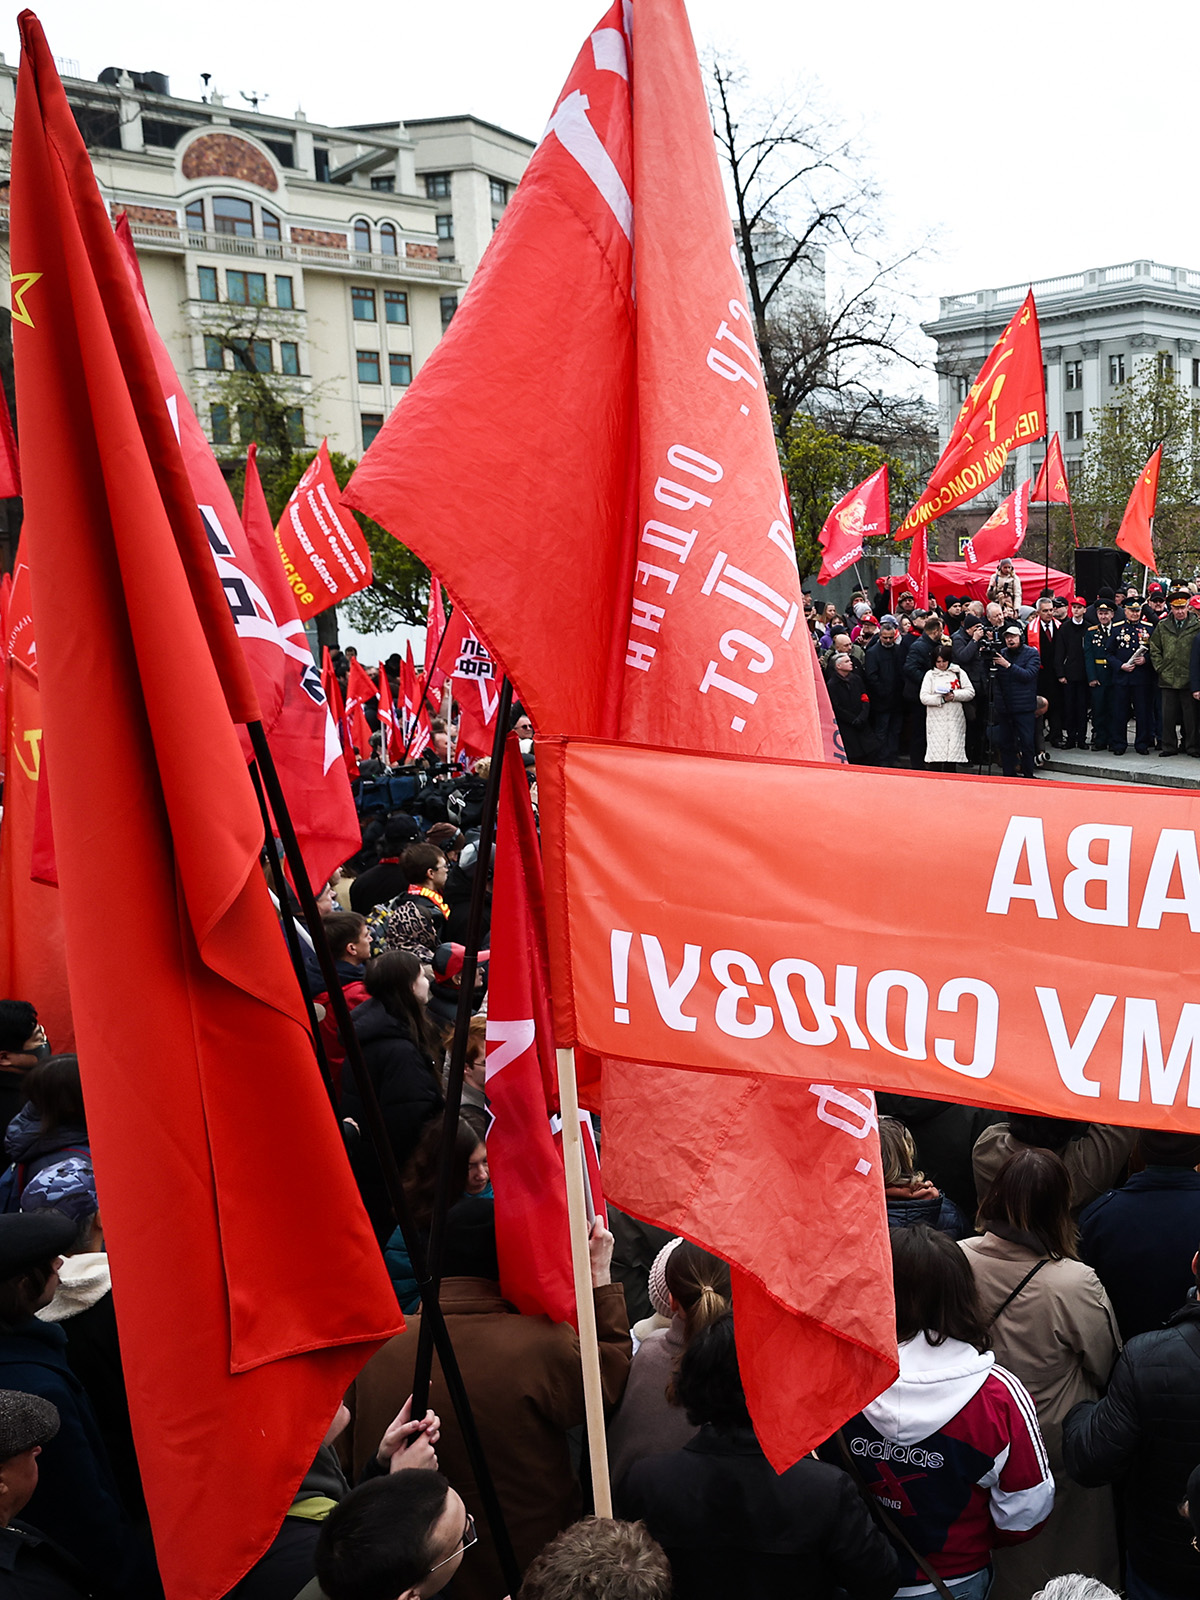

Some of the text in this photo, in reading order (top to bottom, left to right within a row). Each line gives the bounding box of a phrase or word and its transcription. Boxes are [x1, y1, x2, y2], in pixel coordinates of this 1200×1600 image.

[310, 553, 339, 595] область
[328, 535, 359, 584] Федерации
[850, 1437, 945, 1469] adidas
